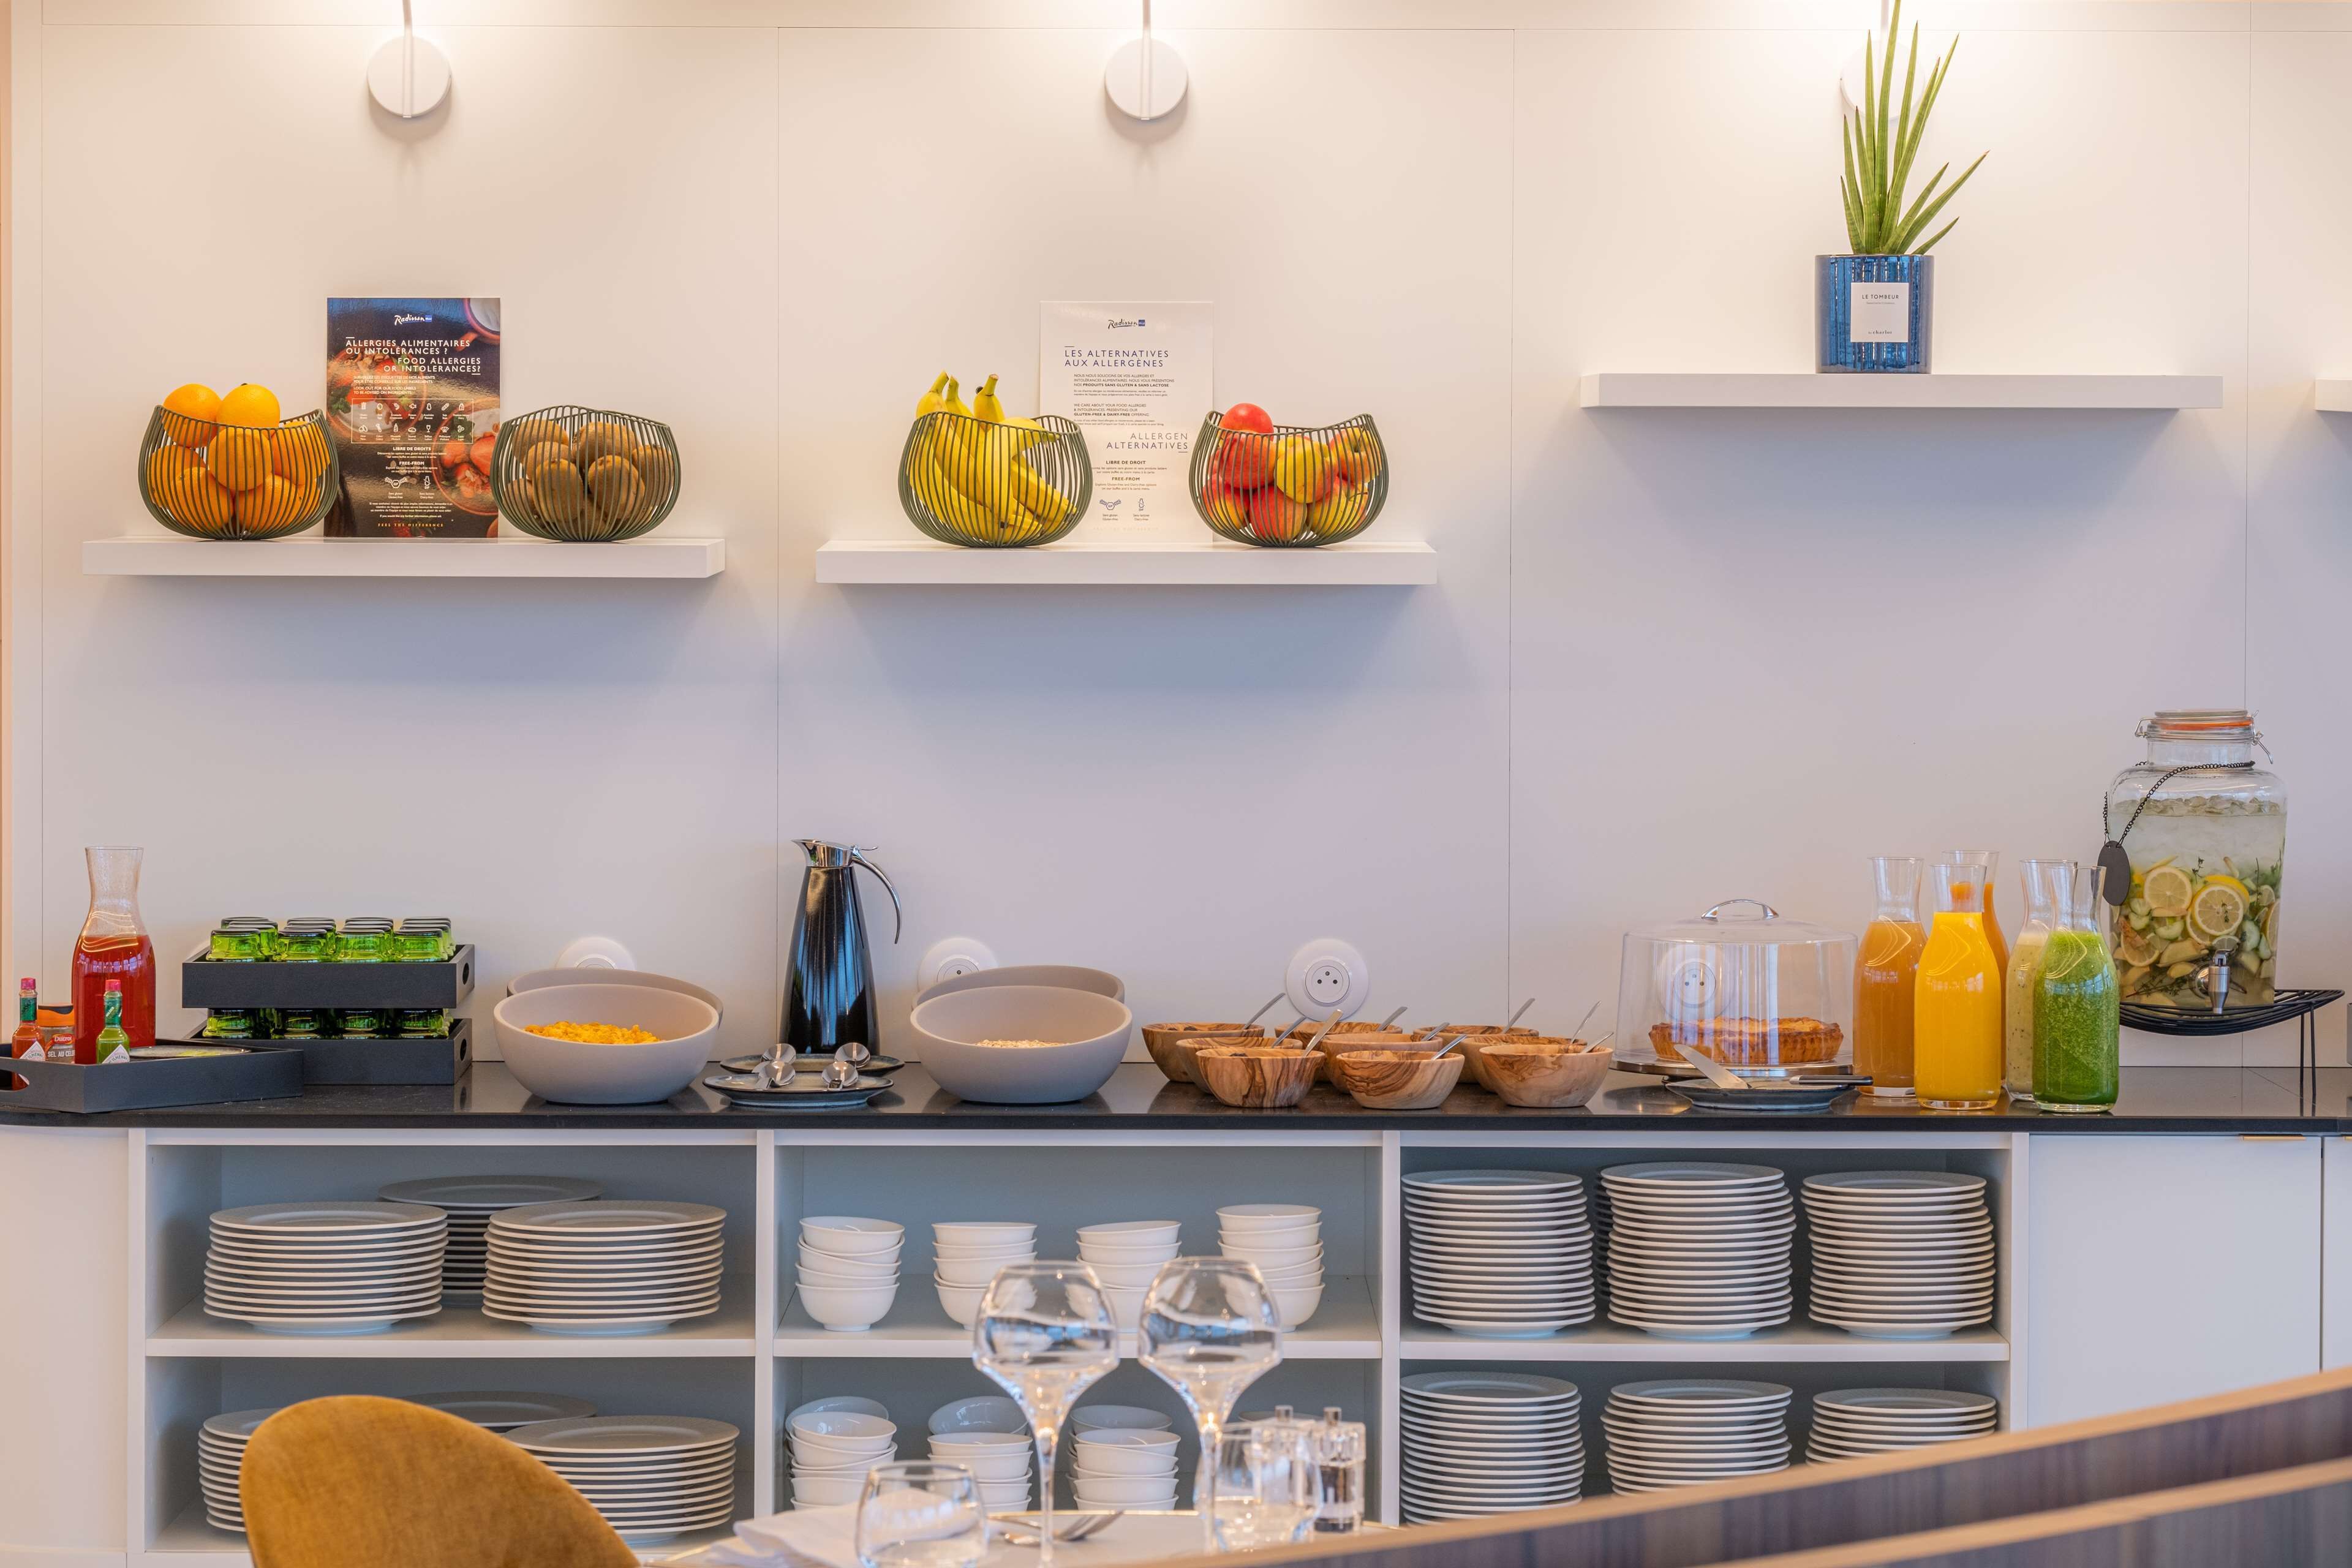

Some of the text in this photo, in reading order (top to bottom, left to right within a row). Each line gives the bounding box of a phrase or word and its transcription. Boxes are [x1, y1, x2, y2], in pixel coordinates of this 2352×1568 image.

[394, 314, 425, 326] Radisson
[1107, 319, 1137, 330] Radisson
[365, 346, 440, 355] INTOLÉRANCES
[1093, 358, 1164, 367] ALLERGÈNES
